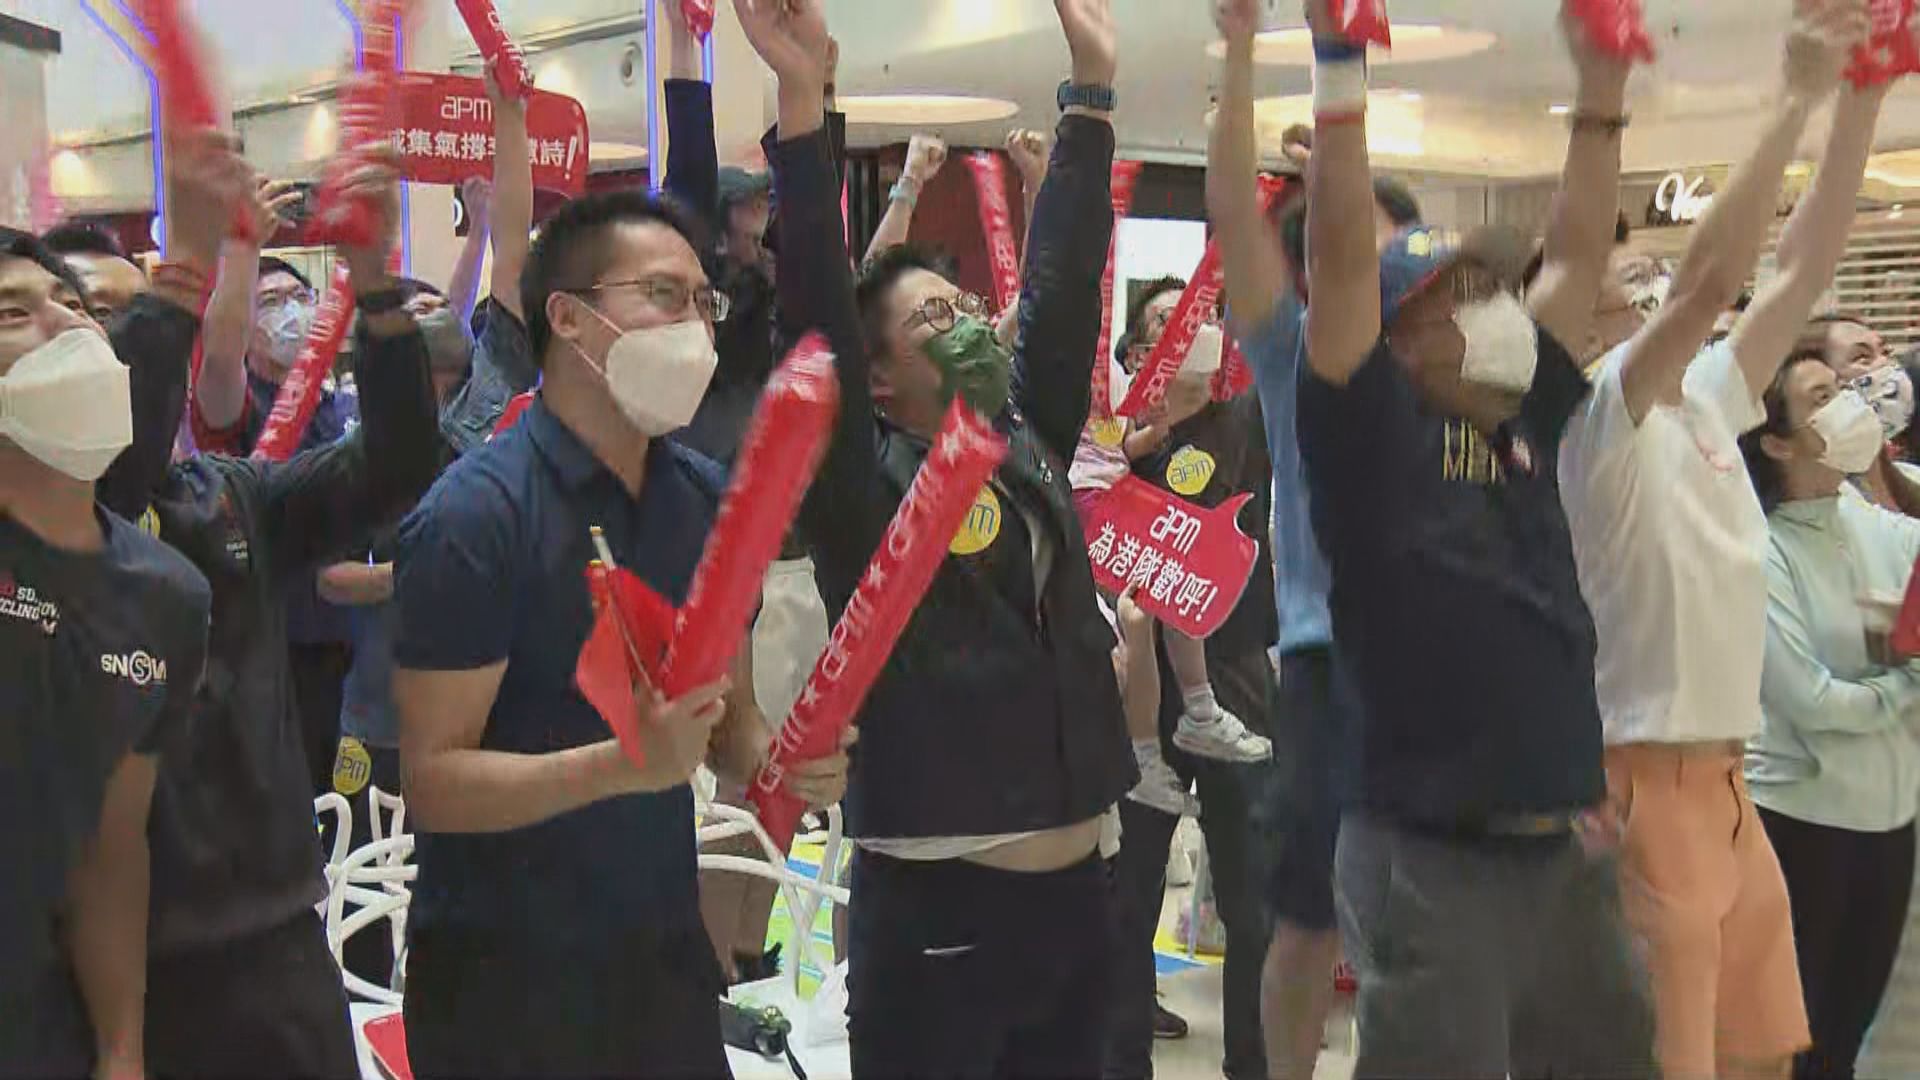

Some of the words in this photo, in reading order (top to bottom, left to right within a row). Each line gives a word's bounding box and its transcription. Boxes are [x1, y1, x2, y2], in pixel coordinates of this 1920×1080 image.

[440, 95, 492, 123] apm
[1169, 459, 1213, 485] apm
[1149, 504, 1202, 556] apm
[1087, 521, 1219, 622] 為港隊歡呼!
